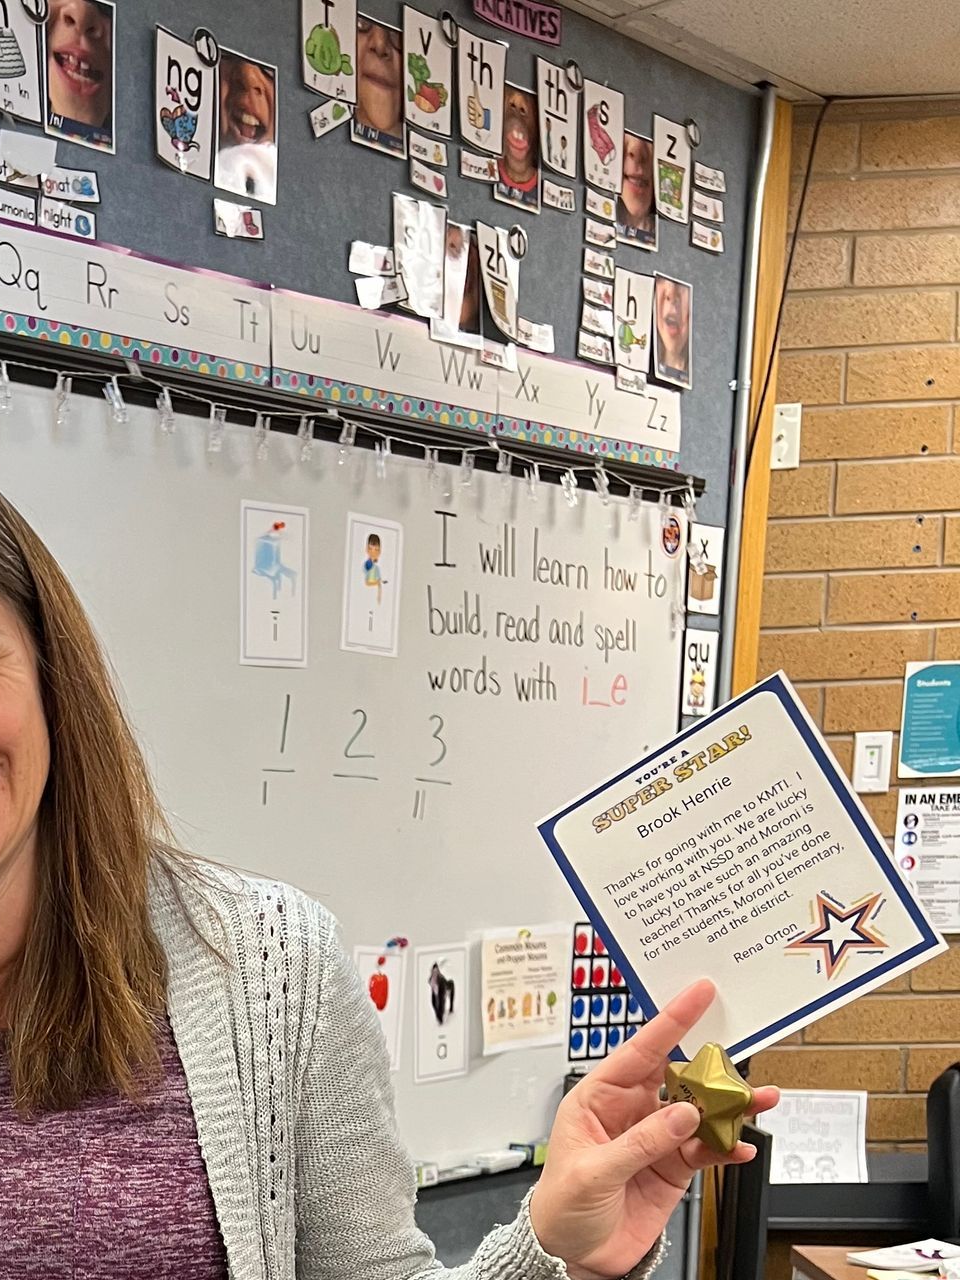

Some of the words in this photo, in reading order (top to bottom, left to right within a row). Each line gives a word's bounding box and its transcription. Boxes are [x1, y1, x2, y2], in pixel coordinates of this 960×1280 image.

[419, 27, 432, 56] v
[476, 0, 559, 38] RICATIVES
[167, 55, 202, 112] ng
[467, 41, 493, 91] th
[545, 69, 568, 116] th
[44, 176, 71, 194] gnat
[43, 207, 73, 228] night
[484, 236, 508, 279] zh
[86, 261, 120, 310] Rr
[163, 282, 190, 327] Ss
[233, 298, 259, 343] Tt
[626, 278, 638, 320] h
[290, 311, 321, 354] Uu
[375, 328, 401, 372] Vv
[439, 345, 483, 391] Ww
[515, 366, 540, 403] Xx
[585, 380, 606, 429] Yy
[646, 396, 668, 432] Zz
[434, 510, 457, 569] I
[479, 523, 516, 578] will
[532, 527, 588, 590] learn
[604, 547, 638, 592] how
[644, 550, 667, 599] to
[496, 605, 540, 643] read
[549, 610, 584, 648] and
[594, 618, 637, 663] spell
[688, 642, 710, 664] qu
[427, 655, 501, 696] words
[514, 661, 557, 702] with
[343, 708, 376, 759] 2
[428, 714, 447, 767] 3
[592, 777, 673, 834] SUPER
[673, 725, 752, 783] STAR!
[635, 756, 678, 785] YOU'RE
[680, 749, 690, 758] A
[636, 807, 681, 839] Brook
[681, 776, 732, 811] Henrie
[905, 794, 917, 805] IN
[920, 793, 936, 805] AN
[603, 868, 646, 895] Thanks
[645, 856, 662, 871] for
[664, 837, 697, 862] going
[697, 821, 722, 840] with
[723, 809, 742, 825] me
[743, 801, 756, 813] to
[756, 779, 793, 804] KMTI.
[795, 771, 803, 780] I
[614, 890, 639, 908] love
[639, 863, 685, 893] working
[684, 847, 709, 866] with
[710, 834, 735, 853] you.
[734, 819, 755, 835] We
[756, 807, 776, 824] are
[775, 788, 808, 811] lucky
[624, 908, 637, 920] to
[637, 892, 665, 912] have
[666, 879, 687, 898] you
[688, 870, 701, 882] at
[701, 849, 734, 874] NSSD
[736, 834, 758, 854] and
[758, 808, 802, 840] Moroni
[801, 803, 814, 815] is
[639, 913, 686, 946] teacher!
[684, 891, 728, 919] Thanks
[728, 880, 744, 894] for
[747, 869, 762, 884] all
[762, 849, 800, 877] you've
[801, 830, 832, 852] done
[641, 905, 672, 927] lucky
[672, 898, 686, 909] to
[685, 881, 714, 901] have
[715, 863, 744, 884] such
[745, 853, 760, 867] an
[761, 823, 812, 857] amazing
[644, 947, 660, 961] for
[661, 936, 682, 951] the
[682, 906, 734, 940] students,
[733, 881, 775, 910] Moroni
[775, 842, 845, 885] Elementary,
[707, 925, 729, 944] and
[729, 914, 749, 931] the
[750, 889, 794, 919] district.
[525, 941, 547, 951] Nouns
[733, 941, 764, 964] Rena
[764, 922, 798, 945] Orton
